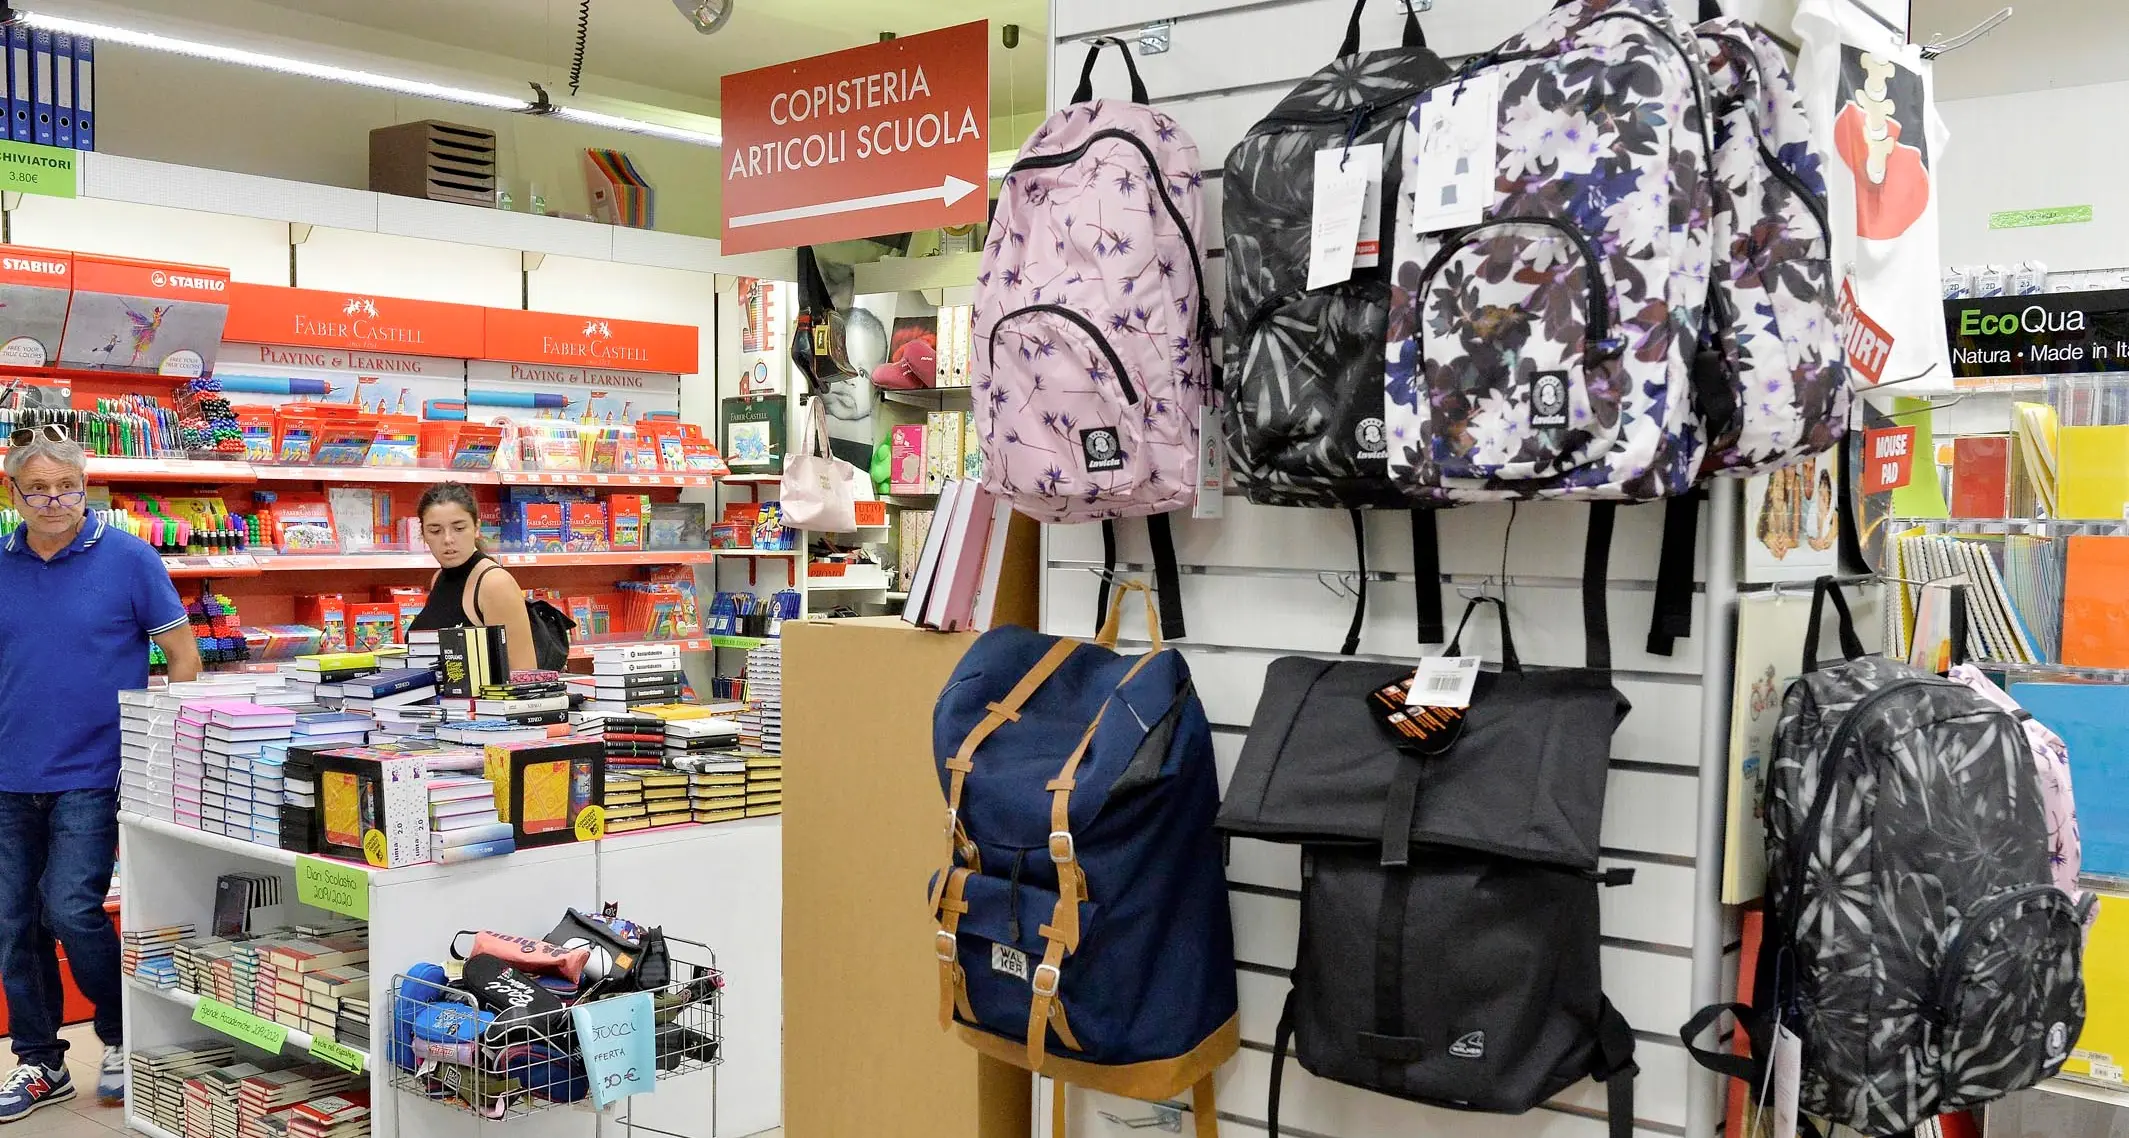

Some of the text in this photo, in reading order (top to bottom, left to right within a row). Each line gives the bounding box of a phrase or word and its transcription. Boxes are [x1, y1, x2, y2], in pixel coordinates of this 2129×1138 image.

[770, 64, 931, 126] COPISTERIA
[728, 105, 981, 181] ARTICOLI SCUOLA
[0, 152, 71, 170] HIVIATORI
[9, 171, 38, 184] 3.80€
[3, 257, 67, 275] STABILO
[169, 275, 226, 292] STABILO
[1960, 305, 2086, 336] EcoQua
[260, 346, 422, 373] PLAYING & LEARNING
[1953, 347, 2011, 364] Natura
[2030, 343, 2084, 362] Made
[2092, 342, 2107, 360] in
[511, 364, 643, 388] PLAYING & LEARNING
[1875, 433, 1908, 459] MOUSE
[1881, 461, 1899, 485] PAD
[594, 1048, 626, 1062] FFERTA
